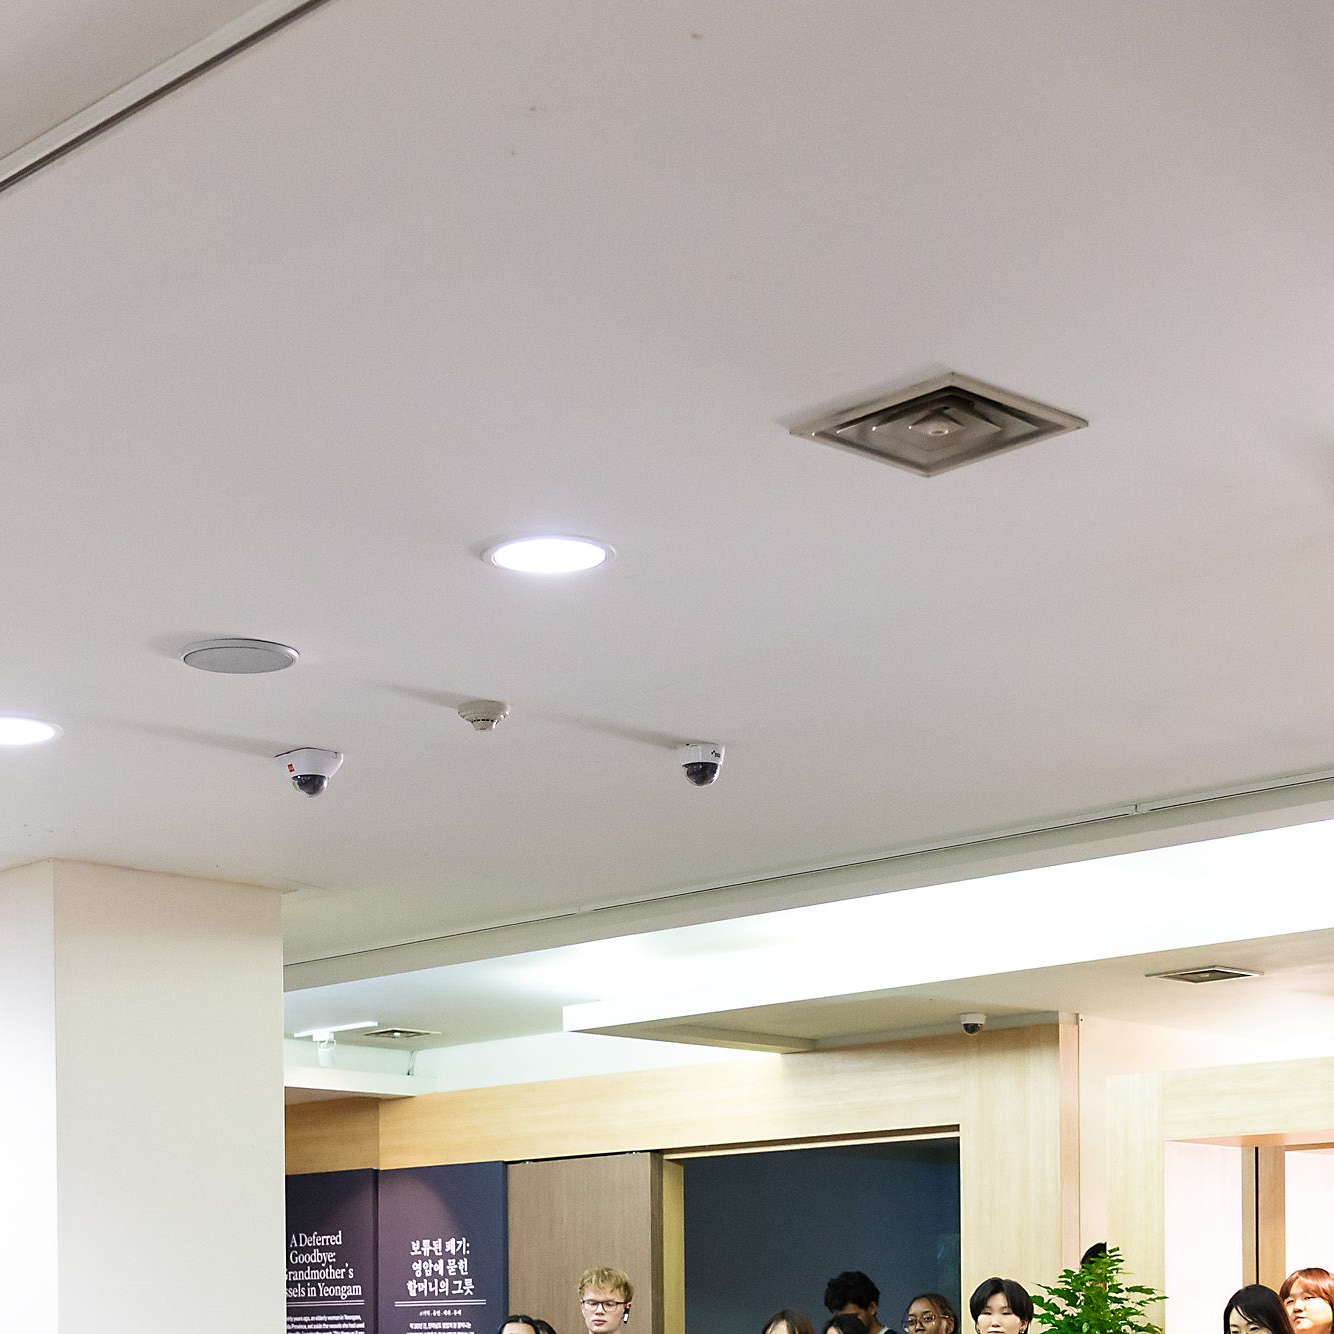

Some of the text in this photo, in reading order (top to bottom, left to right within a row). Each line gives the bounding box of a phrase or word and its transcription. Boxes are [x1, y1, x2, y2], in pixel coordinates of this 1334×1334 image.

[290, 1230, 342, 1247] A Deferred
[410, 1238, 470, 1256] 보류된 폐기:
[290, 1249, 336, 1266] Goodbye:
[412, 1258, 468, 1277] 영암에 묻힌
[307, 1283, 316, 1296] in
[318, 1283, 362, 1300] Yeongam
[407, 1278, 474, 1296] 할머니의 그릇
